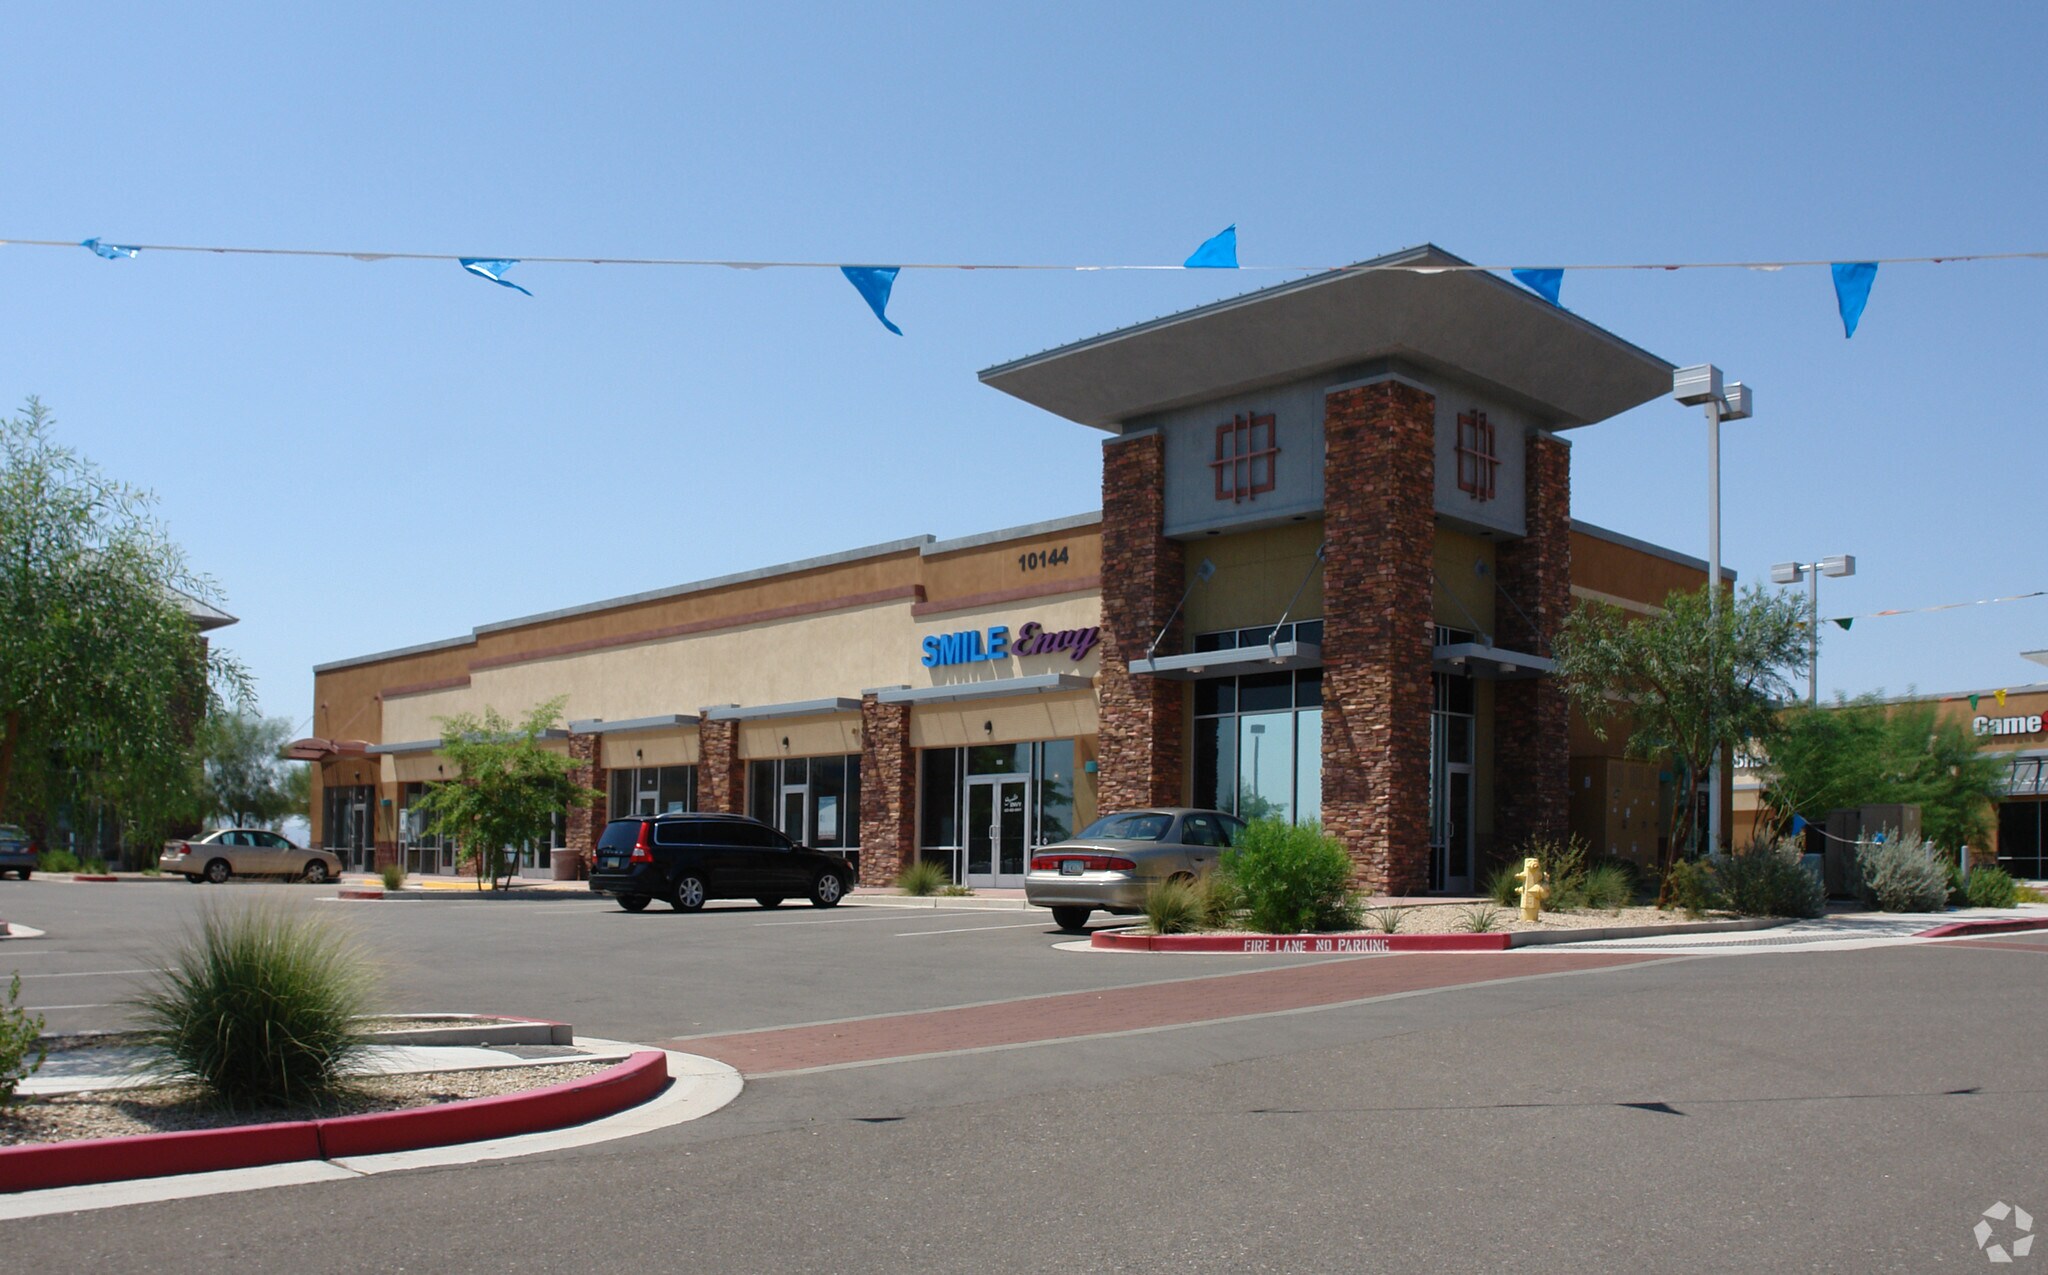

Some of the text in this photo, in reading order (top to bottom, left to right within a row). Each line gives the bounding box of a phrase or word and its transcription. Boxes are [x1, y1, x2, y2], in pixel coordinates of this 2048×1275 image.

[1018, 546, 1069, 572] 10144
[921, 621, 1100, 668] SMILE Envy
[1244, 938, 1390, 953] FIRE LANE NO PARKING
